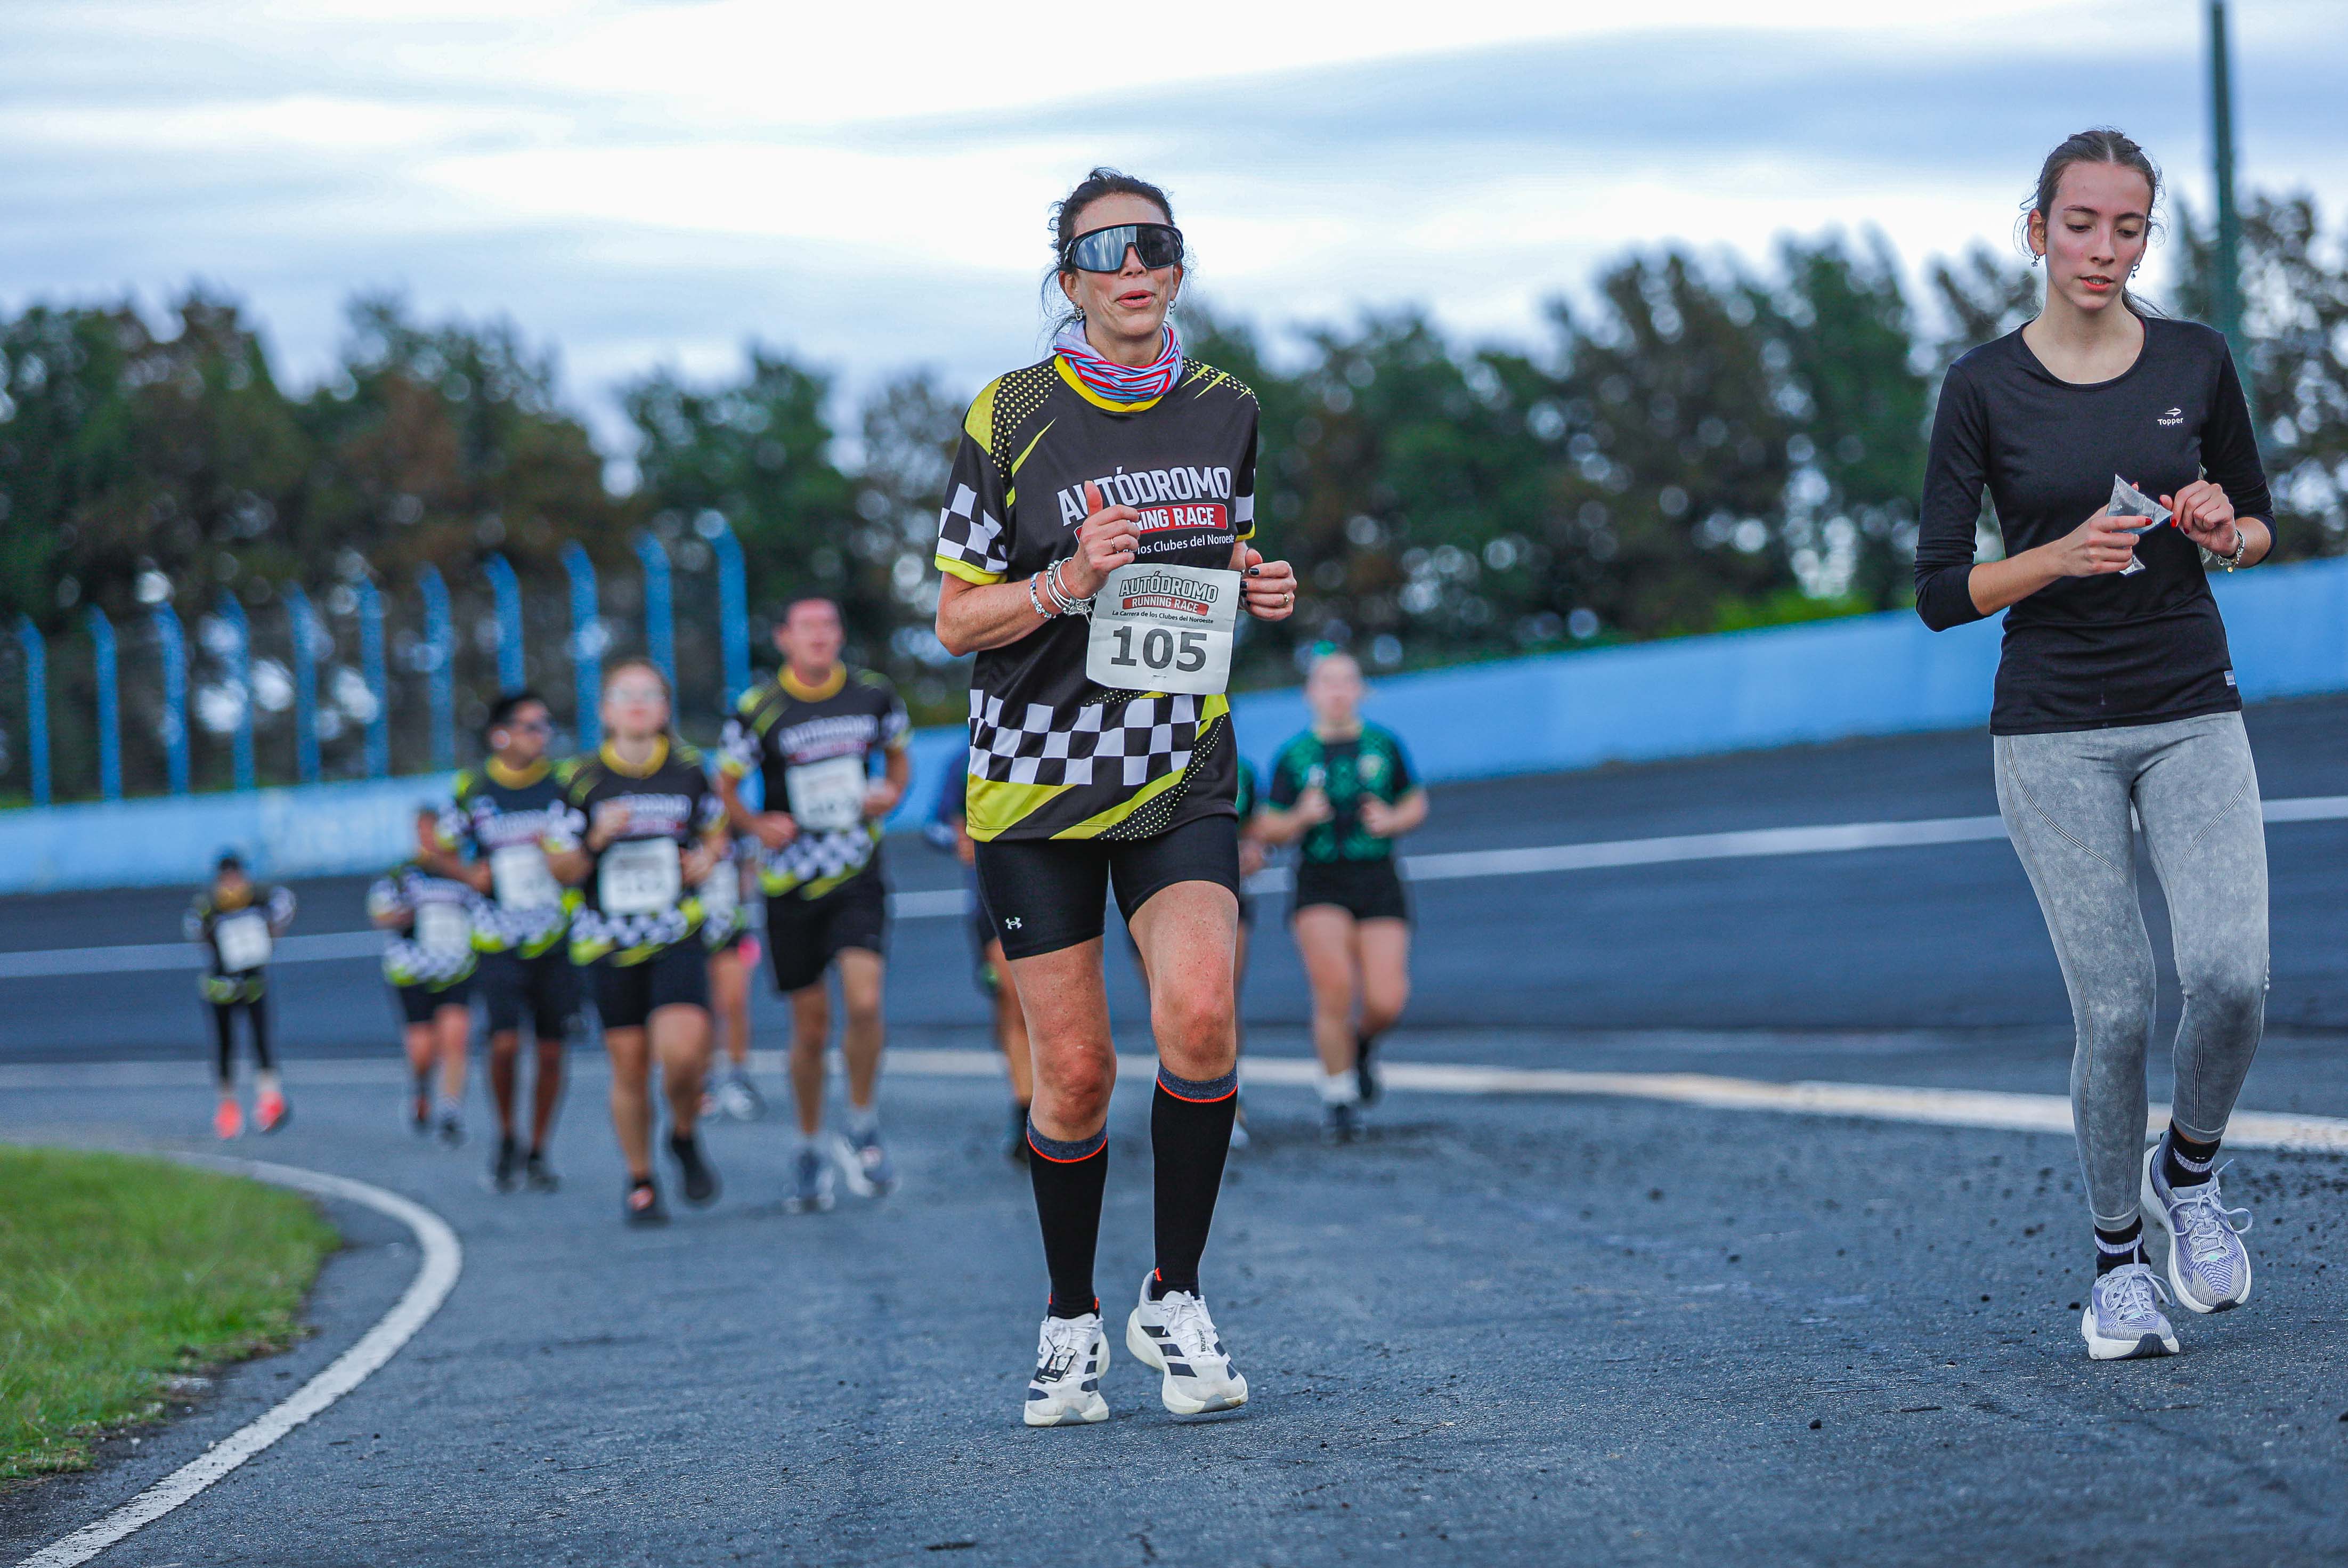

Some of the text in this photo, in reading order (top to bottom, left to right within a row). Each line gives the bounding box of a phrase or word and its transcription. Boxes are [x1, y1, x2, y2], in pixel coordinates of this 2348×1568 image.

[1172, 507, 1216, 526] RACE
[1153, 539, 1188, 553] Clubes
[1190, 535, 1205, 547] del
[1207, 534, 1234, 545] Noroeste
[1119, 571, 1219, 603] AUTÓDROMO
[1132, 595, 1199, 613] RUNNING RACE
[1111, 625, 1207, 672] 105
